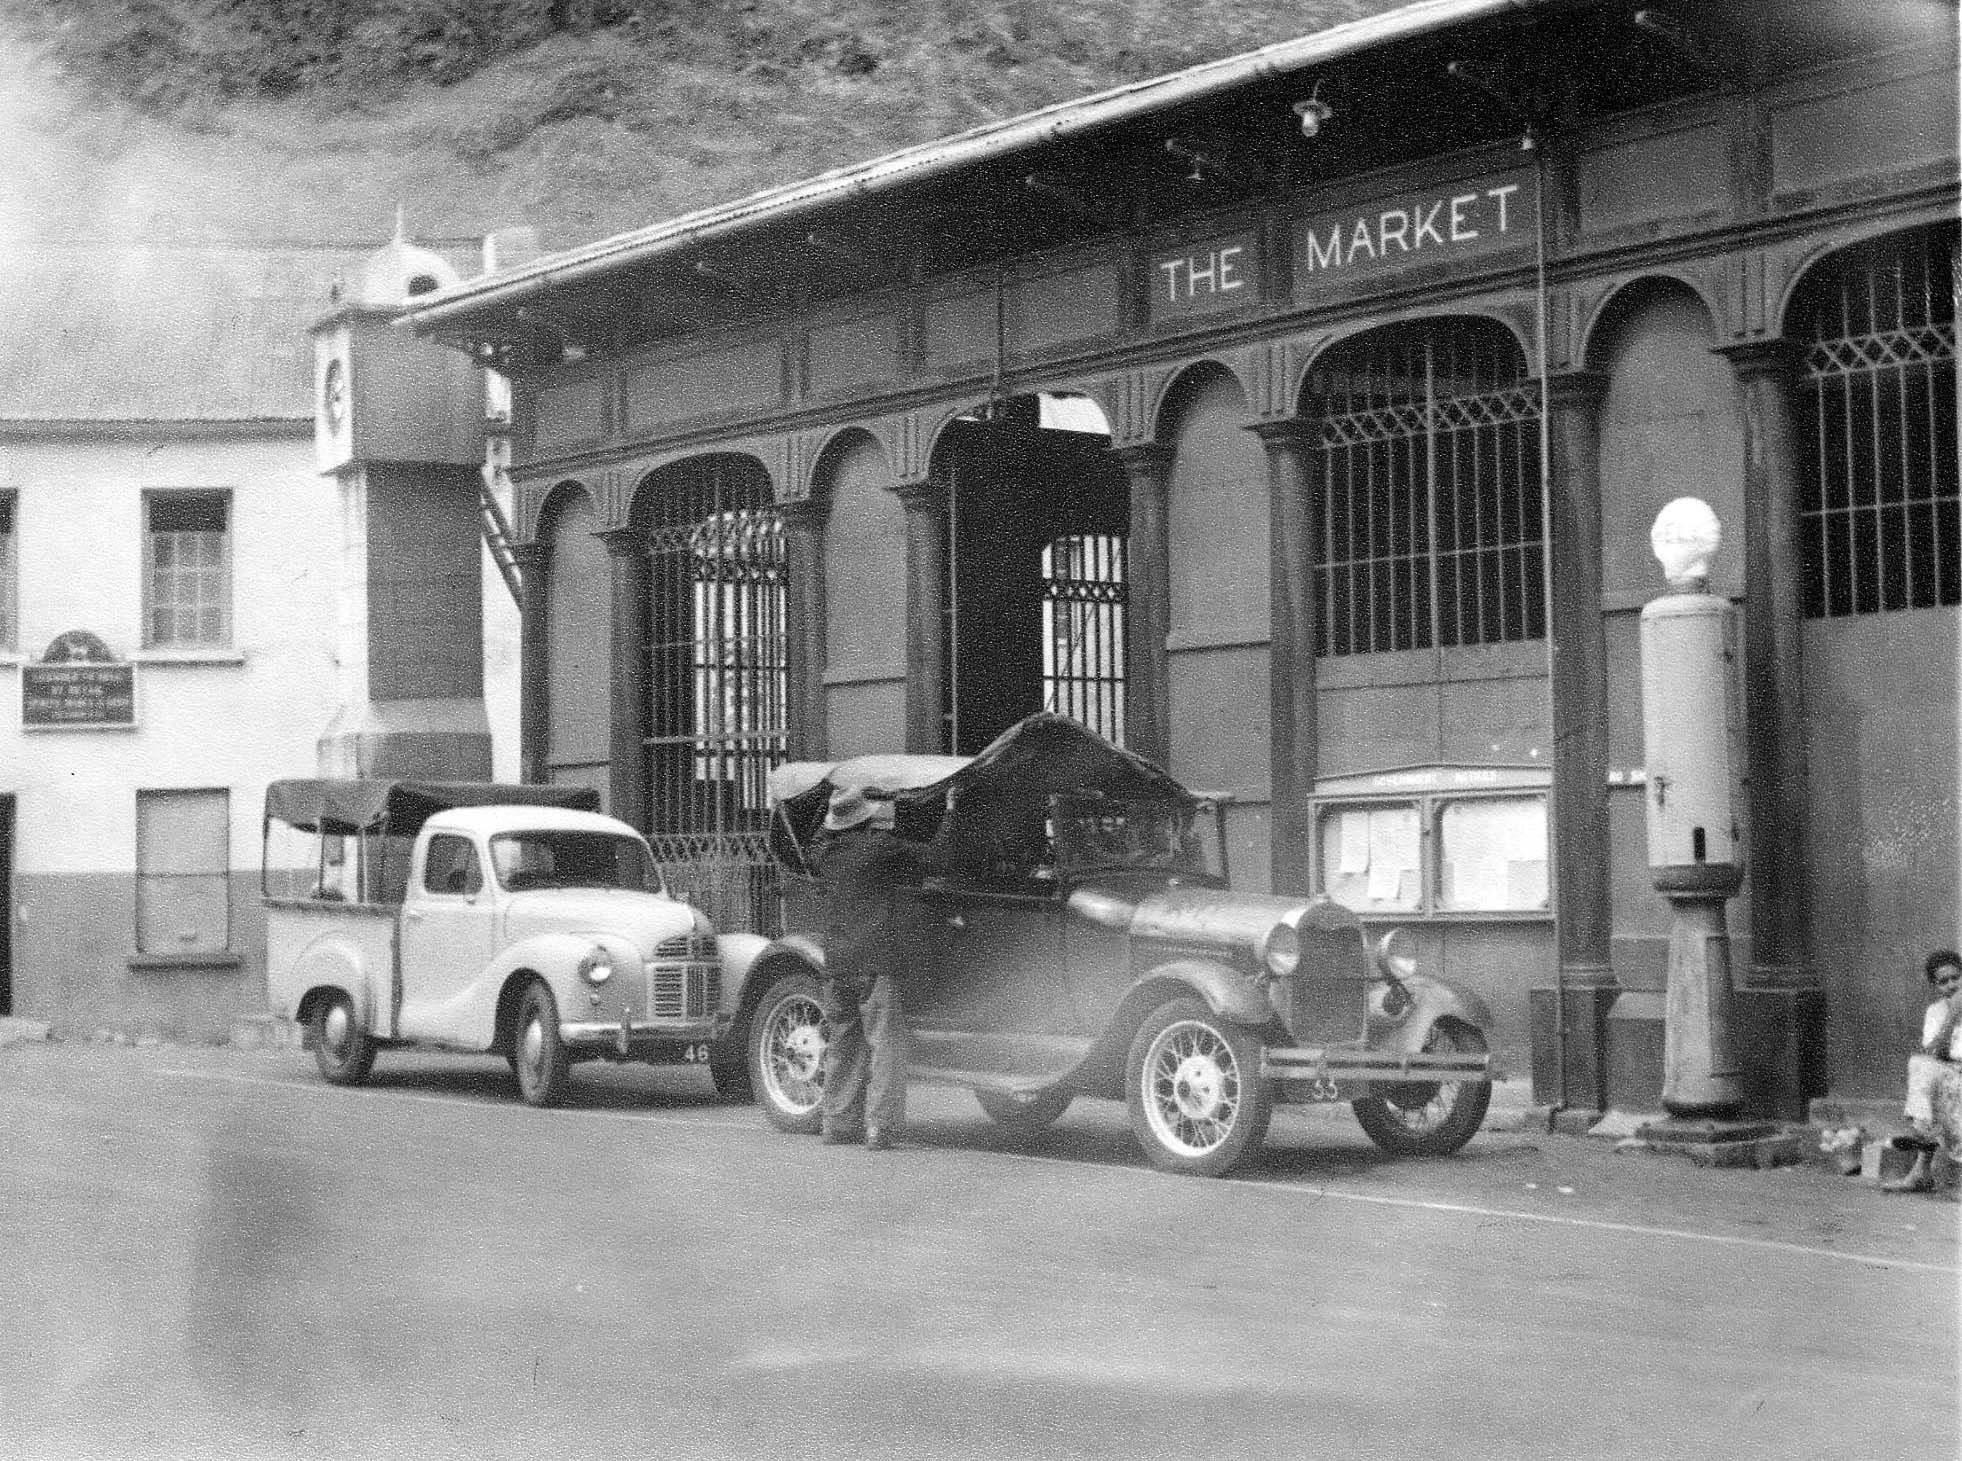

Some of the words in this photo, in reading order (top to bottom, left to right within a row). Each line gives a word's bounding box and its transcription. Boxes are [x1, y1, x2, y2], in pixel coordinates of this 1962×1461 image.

[1159, 247, 1244, 302] THE
[1306, 184, 1519, 272] MARKET
[684, 1044, 709, 1062] 46
